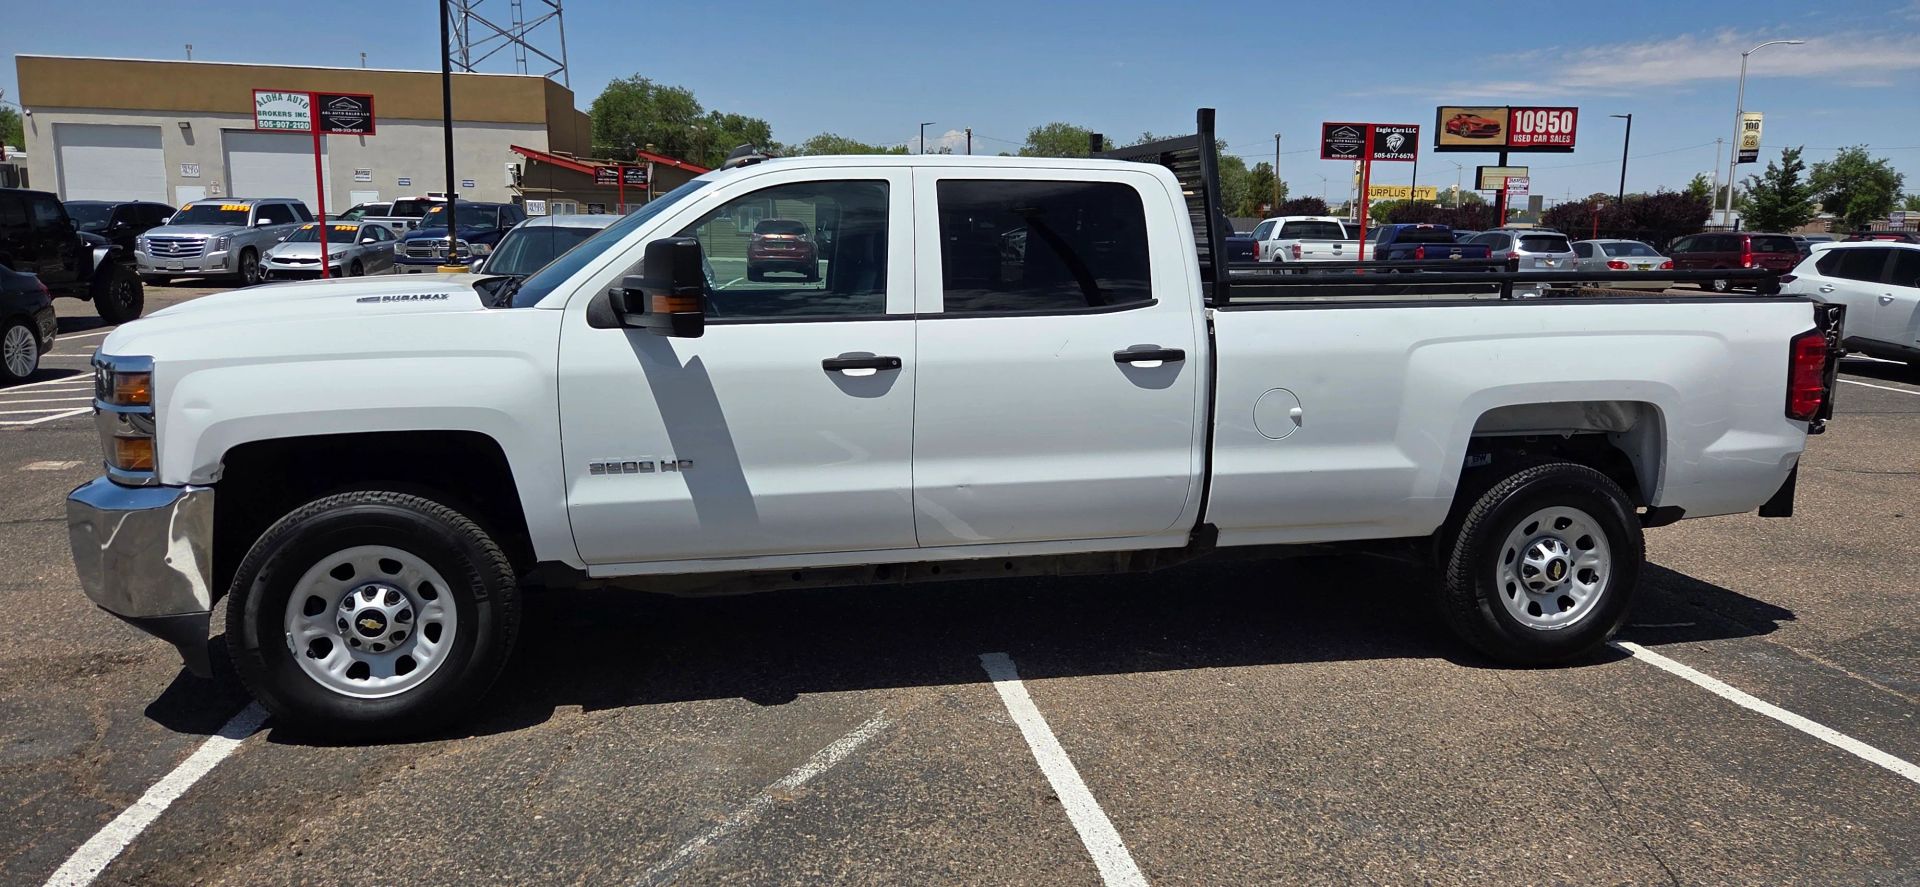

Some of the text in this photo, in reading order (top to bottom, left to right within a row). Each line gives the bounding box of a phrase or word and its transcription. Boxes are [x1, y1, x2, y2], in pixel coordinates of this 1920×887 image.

[256, 93, 309, 109] ALOHA AUTO
[258, 110, 292, 118] BROKERS
[259, 120, 310, 129] 505-907-2120
[1515, 110, 1573, 134] 10950
[1745, 122, 1759, 130] 100
[1375, 126, 1391, 134] Eagle
[1513, 134, 1531, 142] USED
[1550, 135, 1571, 143] SALES
[1411, 189, 1431, 198] CITY
[382, 293, 450, 303] DURAMAX
[589, 460, 694, 475] 3500 HD
